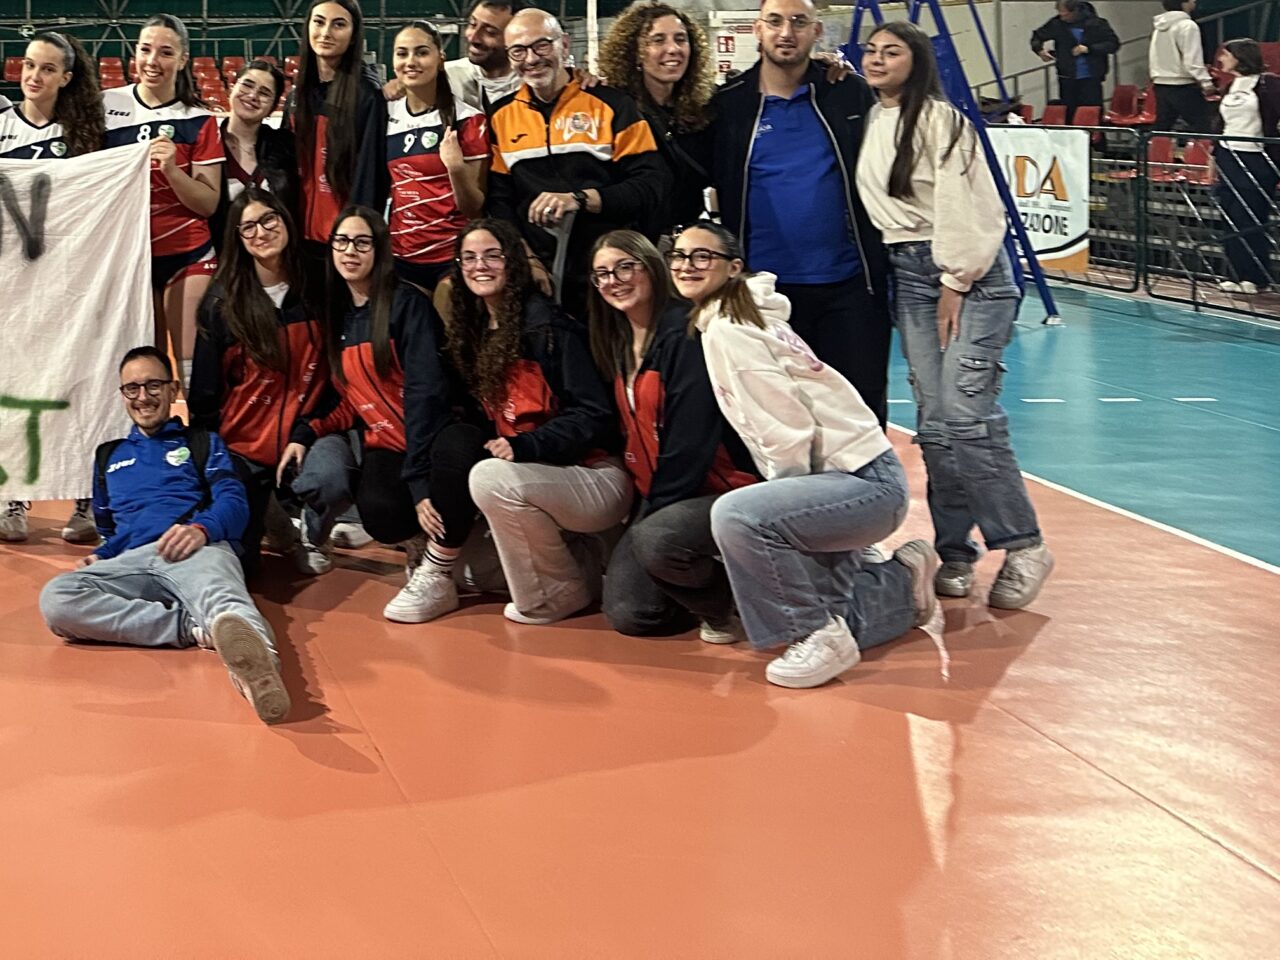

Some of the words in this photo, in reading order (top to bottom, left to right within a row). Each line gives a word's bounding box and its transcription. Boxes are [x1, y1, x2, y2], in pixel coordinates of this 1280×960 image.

[107, 109, 131, 117] Zeus
[137, 124, 151, 142] 8
[402, 133, 415, 153] 9
[30, 145, 45, 159] 7
